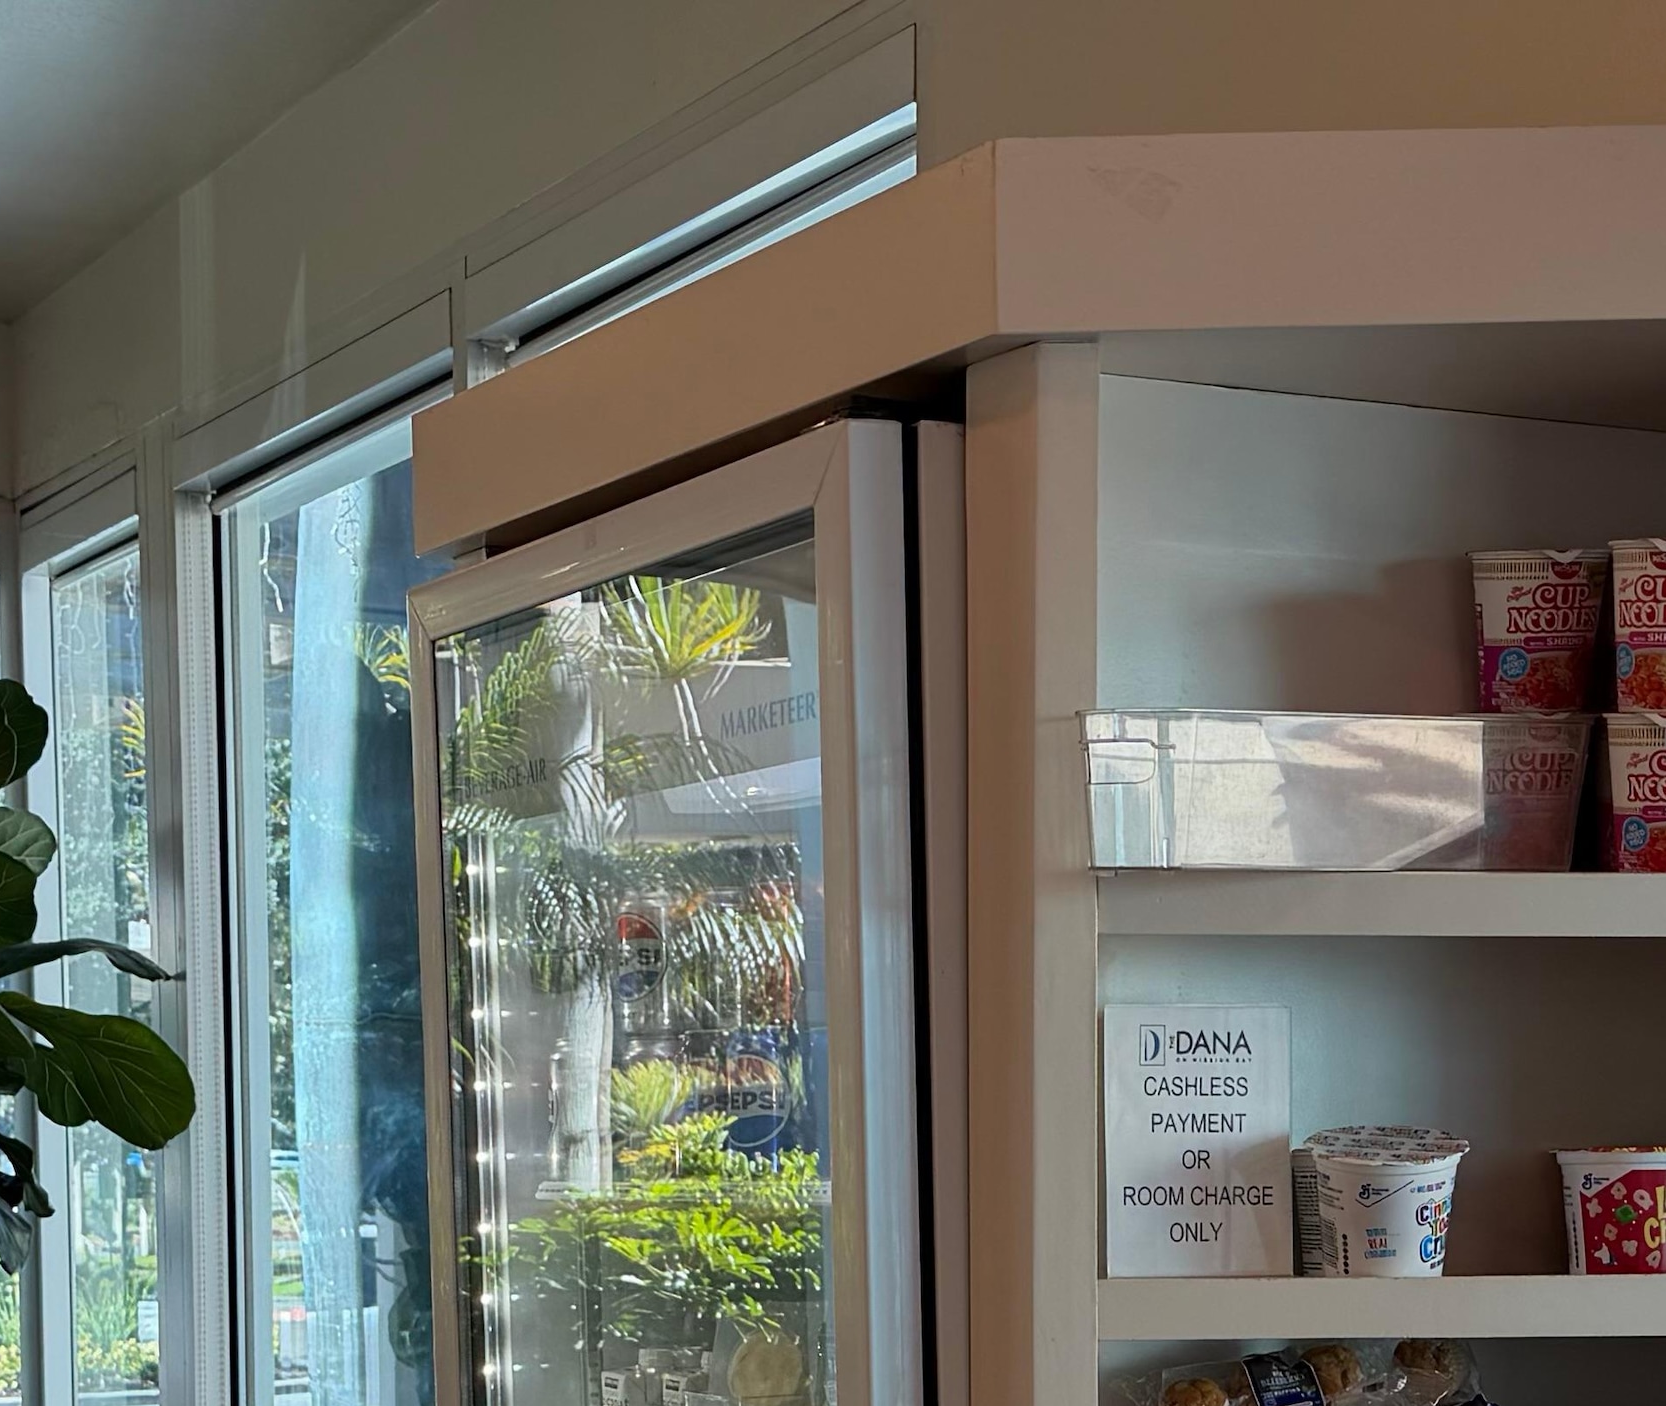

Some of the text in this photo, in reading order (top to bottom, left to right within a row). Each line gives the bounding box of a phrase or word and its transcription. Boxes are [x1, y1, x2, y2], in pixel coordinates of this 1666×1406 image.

[1533, 584, 1590, 608] CUP
[1508, 607, 1597, 633] NOODLES
[720, 692, 816, 740] MARKETEER
[1487, 770, 1572, 794] NOODLE
[1176, 1029, 1252, 1055] DANA
[1144, 1076, 1248, 1097] CASHLESS
[1151, 1113, 1246, 1133] PAYMENT
[1182, 1150, 1210, 1169] OR
[1123, 1186, 1274, 1206] ROOM CHARGE
[1169, 1222, 1223, 1242] ONLY
